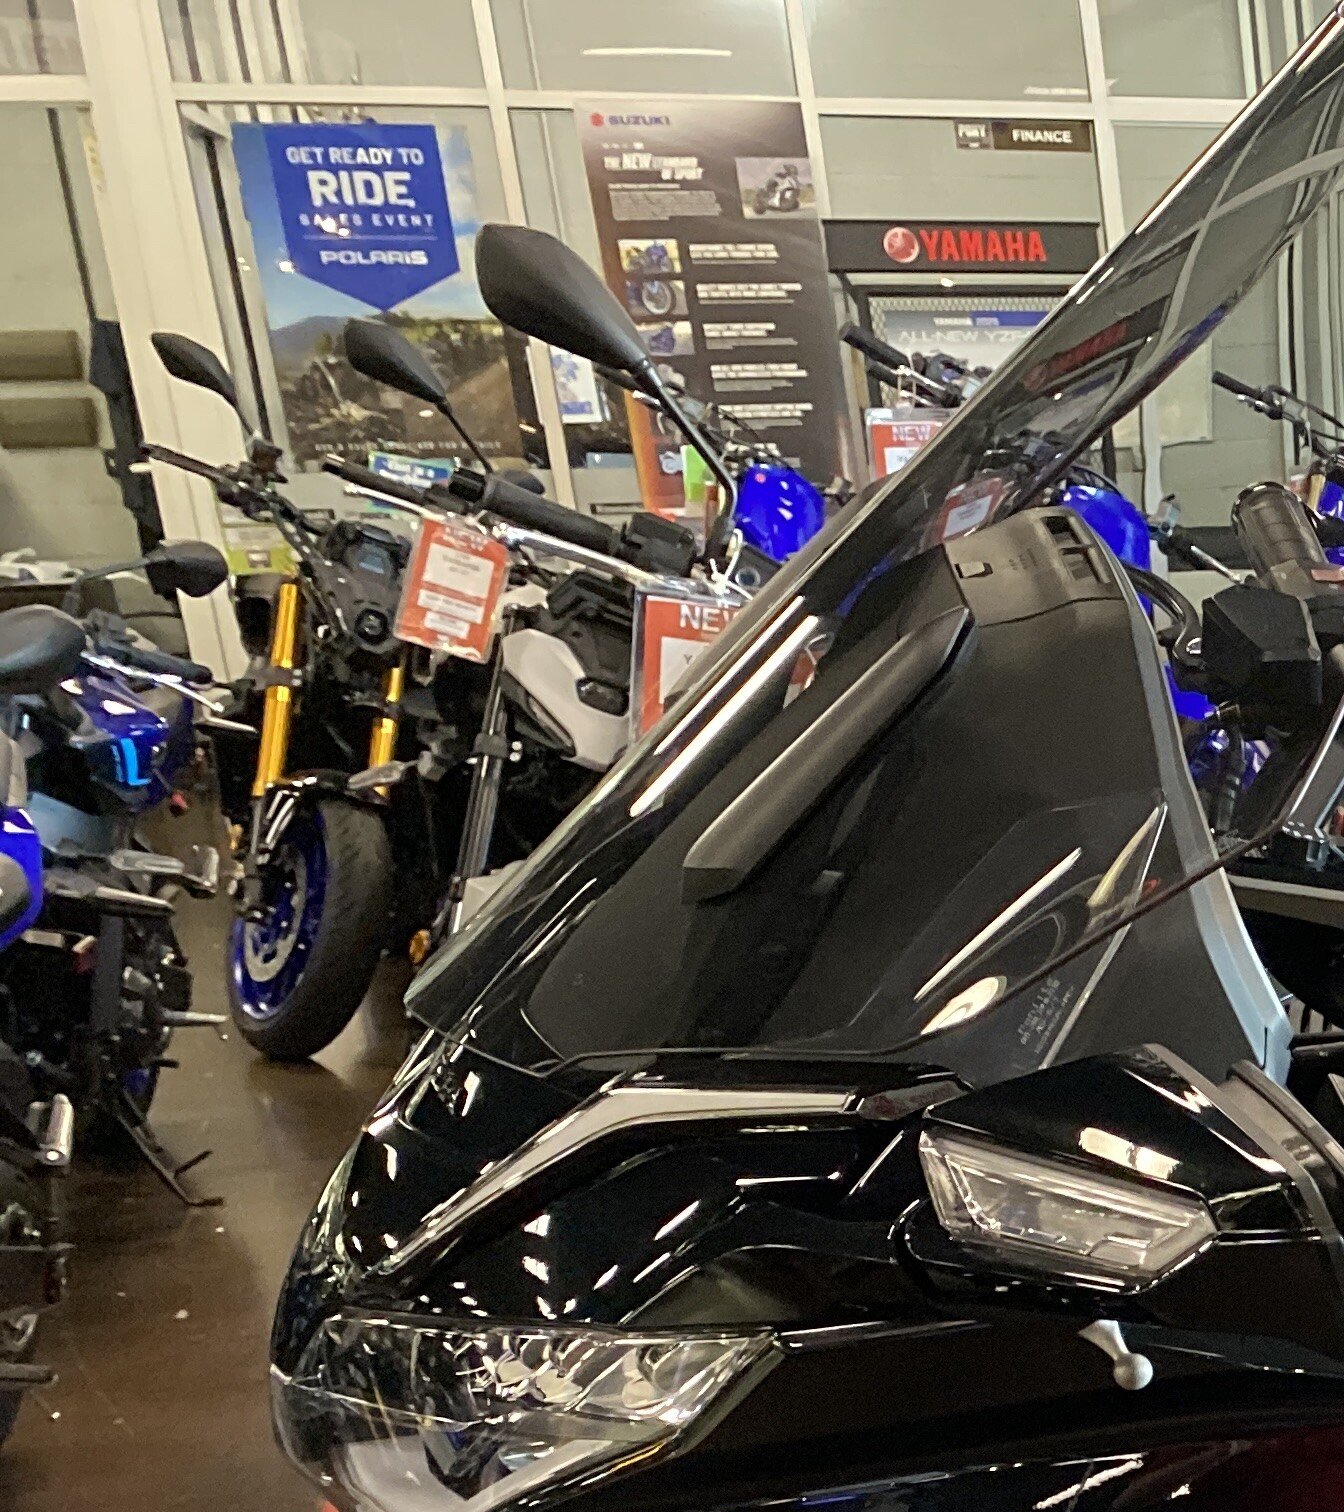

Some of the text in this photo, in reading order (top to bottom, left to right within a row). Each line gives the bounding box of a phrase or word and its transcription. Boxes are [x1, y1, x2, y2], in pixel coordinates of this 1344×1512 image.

[608, 115, 670, 127] SUZUKI
[1012, 129, 1073, 143] FINANCE
[285, 146, 425, 166] GET READY TO
[307, 170, 416, 208] RIDE
[370, 213, 434, 227] EVENT
[919, 230, 1047, 262] YAMAHA
[319, 250, 429, 265] POLARIS
[892, 425, 931, 442] NEW
